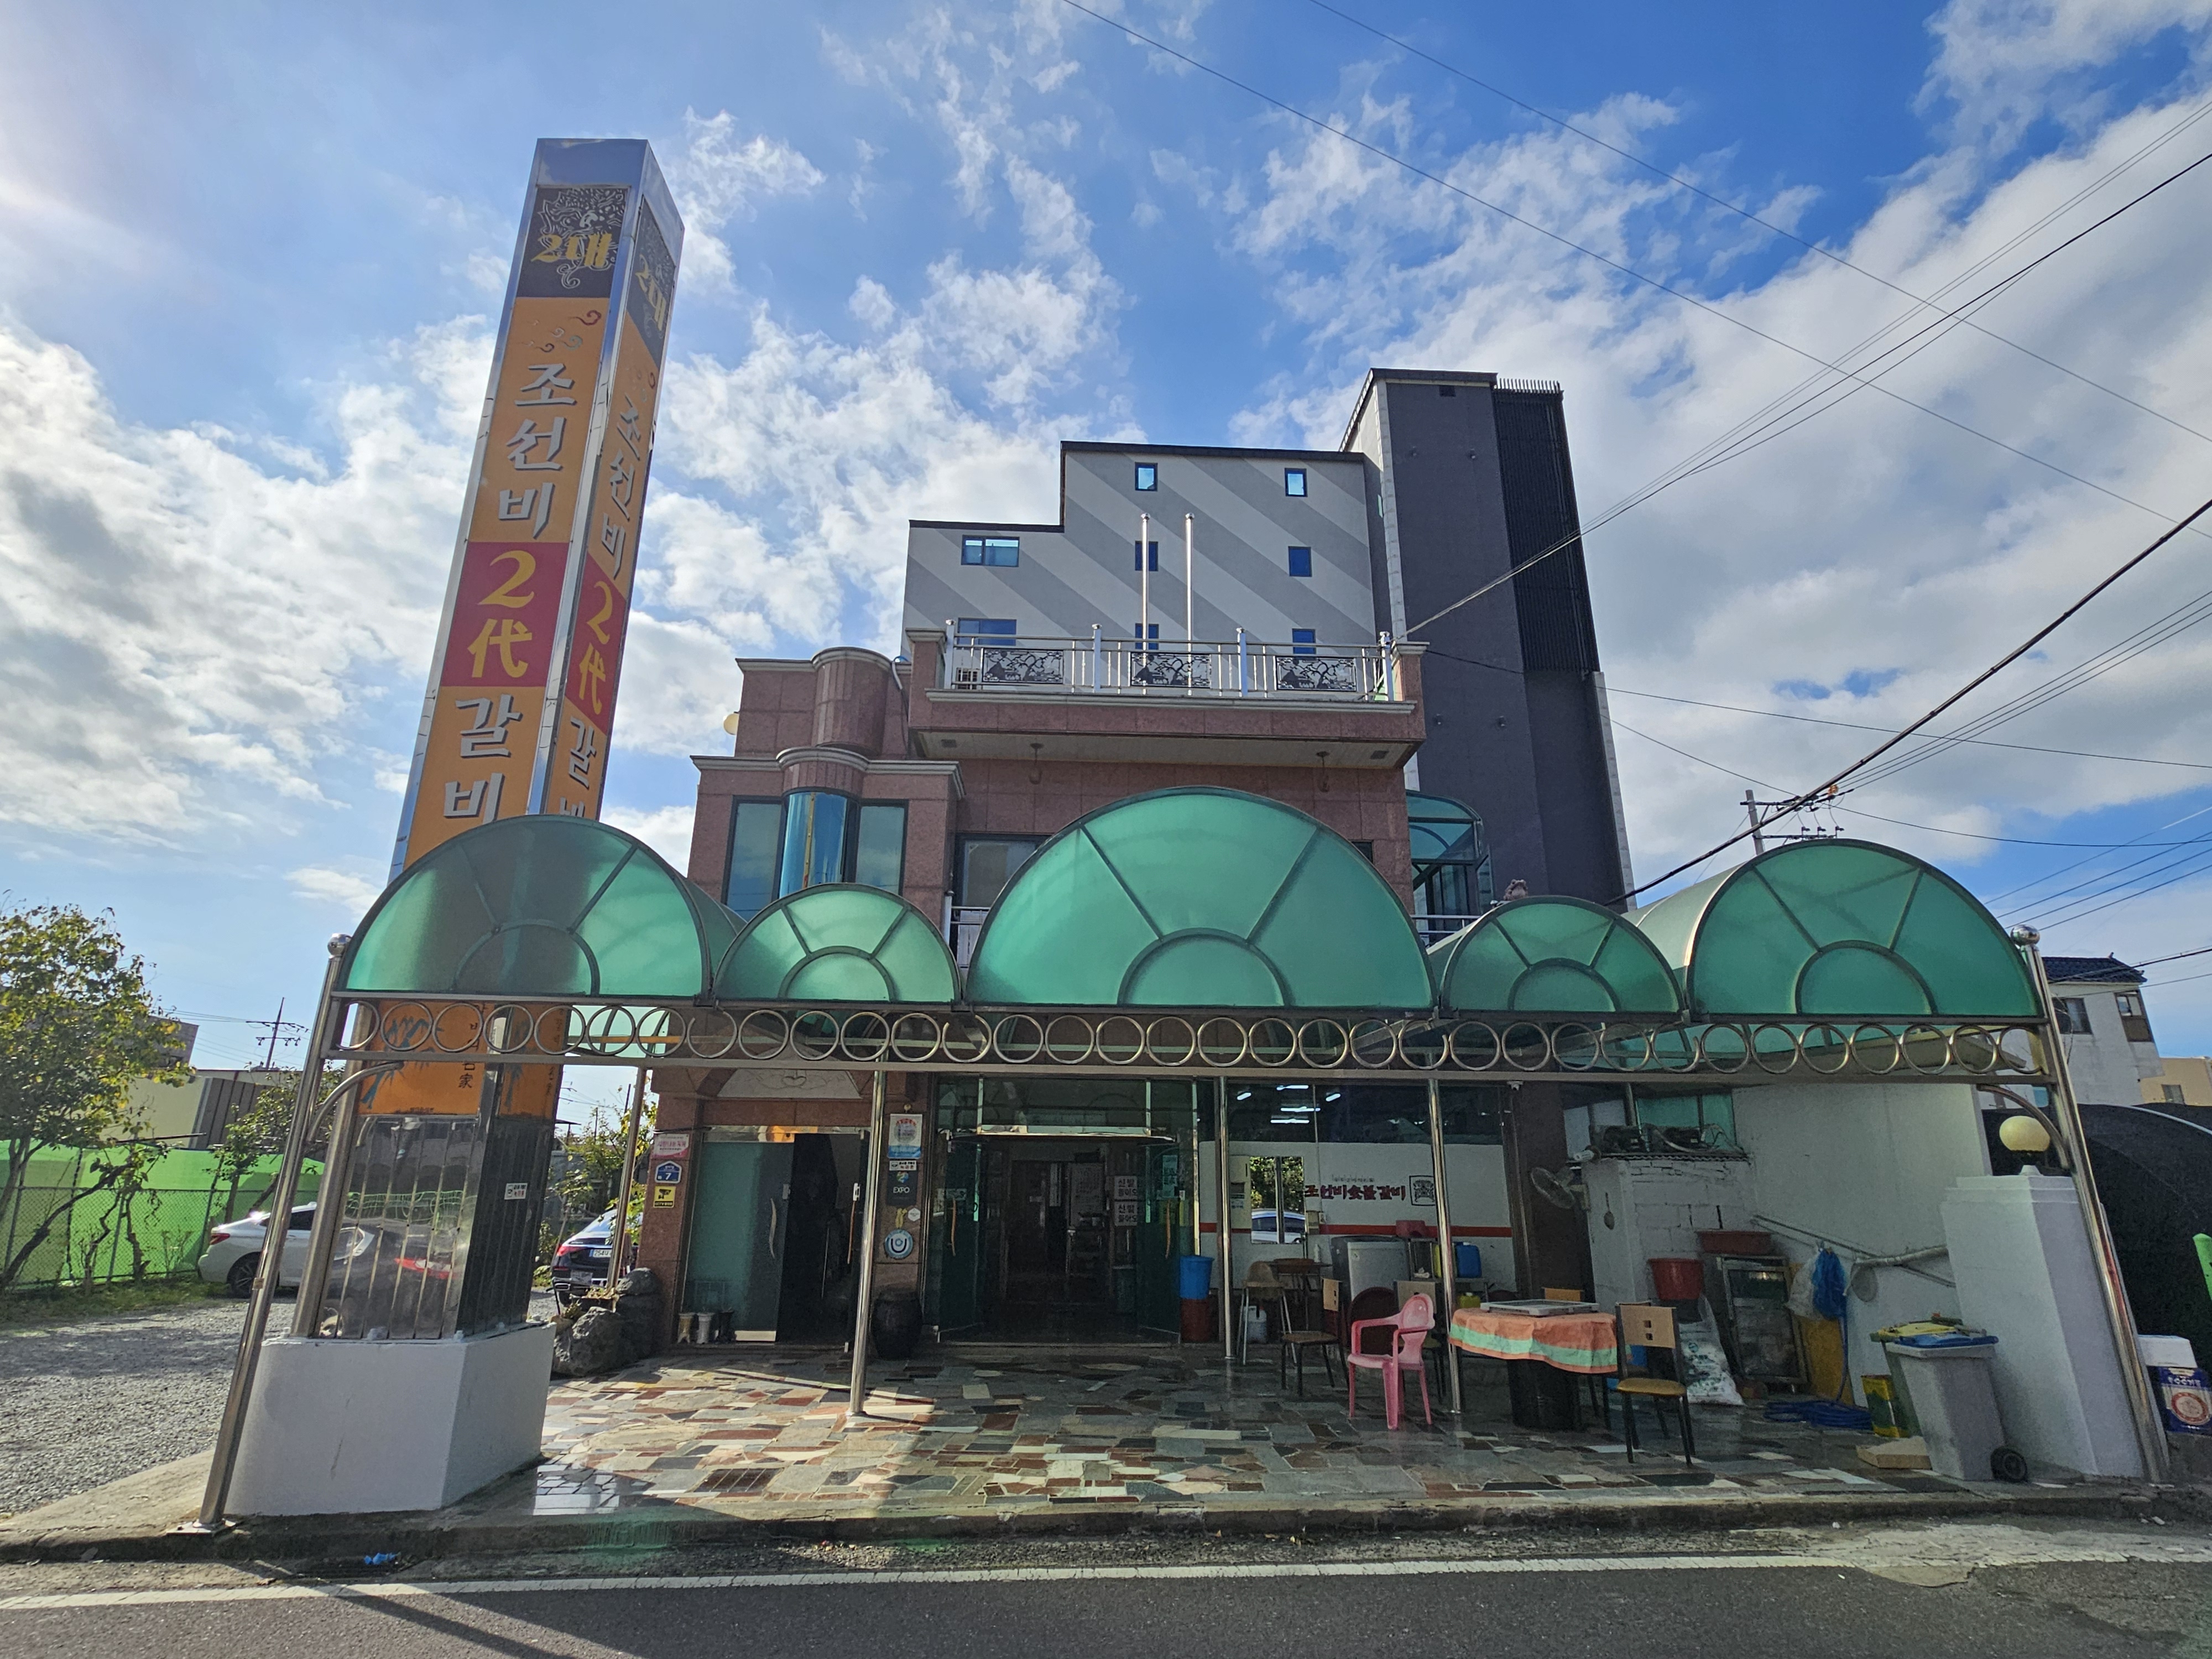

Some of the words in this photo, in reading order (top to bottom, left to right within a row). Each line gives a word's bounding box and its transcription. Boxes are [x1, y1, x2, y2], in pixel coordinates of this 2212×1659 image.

[498, 362, 577, 539] 조선비
[600, 393, 643, 582] 조선비
[467, 549, 537, 679] 2代
[578, 581, 613, 716] 2代
[443, 693, 524, 823] 갈비
